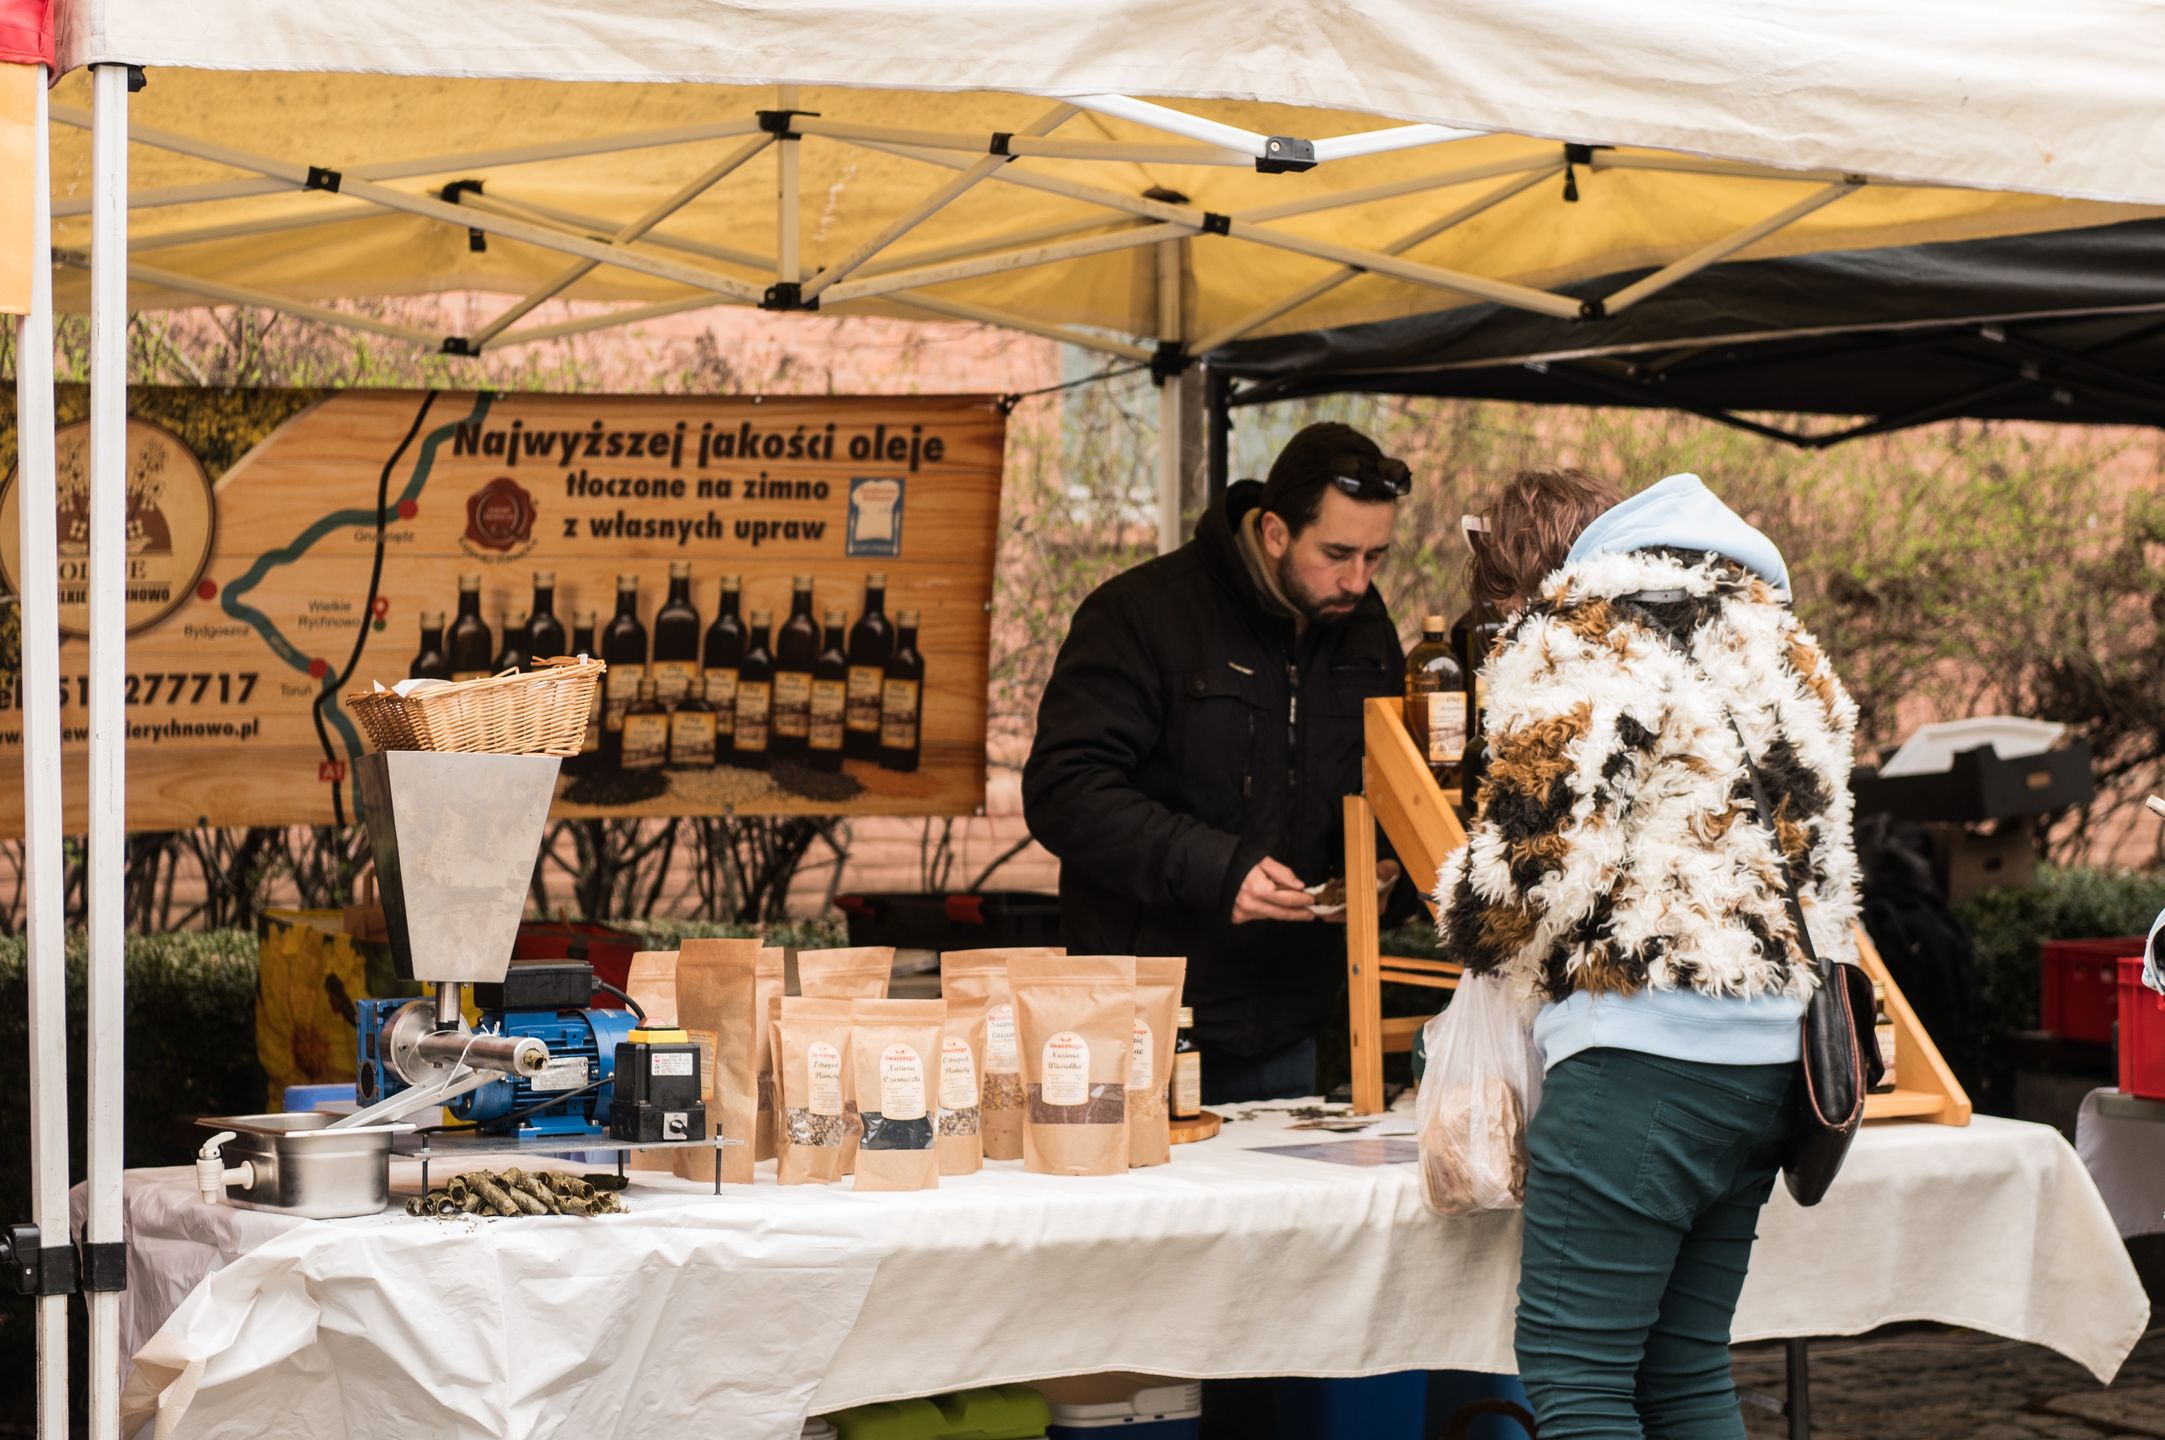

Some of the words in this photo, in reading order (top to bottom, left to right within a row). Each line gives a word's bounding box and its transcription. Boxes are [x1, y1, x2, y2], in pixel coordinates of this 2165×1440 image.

[453, 419, 687, 468] Najwyższej
[698, 421, 836, 469] jakości
[849, 423, 945, 473] oleje
[566, 469, 687, 498] tłoczone
[697, 477, 732, 499] na
[743, 471, 830, 501] zimno
[563, 517, 579, 538] z
[589, 510, 723, 547] własnych
[734, 519, 826, 547] upraw
[58, 672, 259, 705] 51277717
